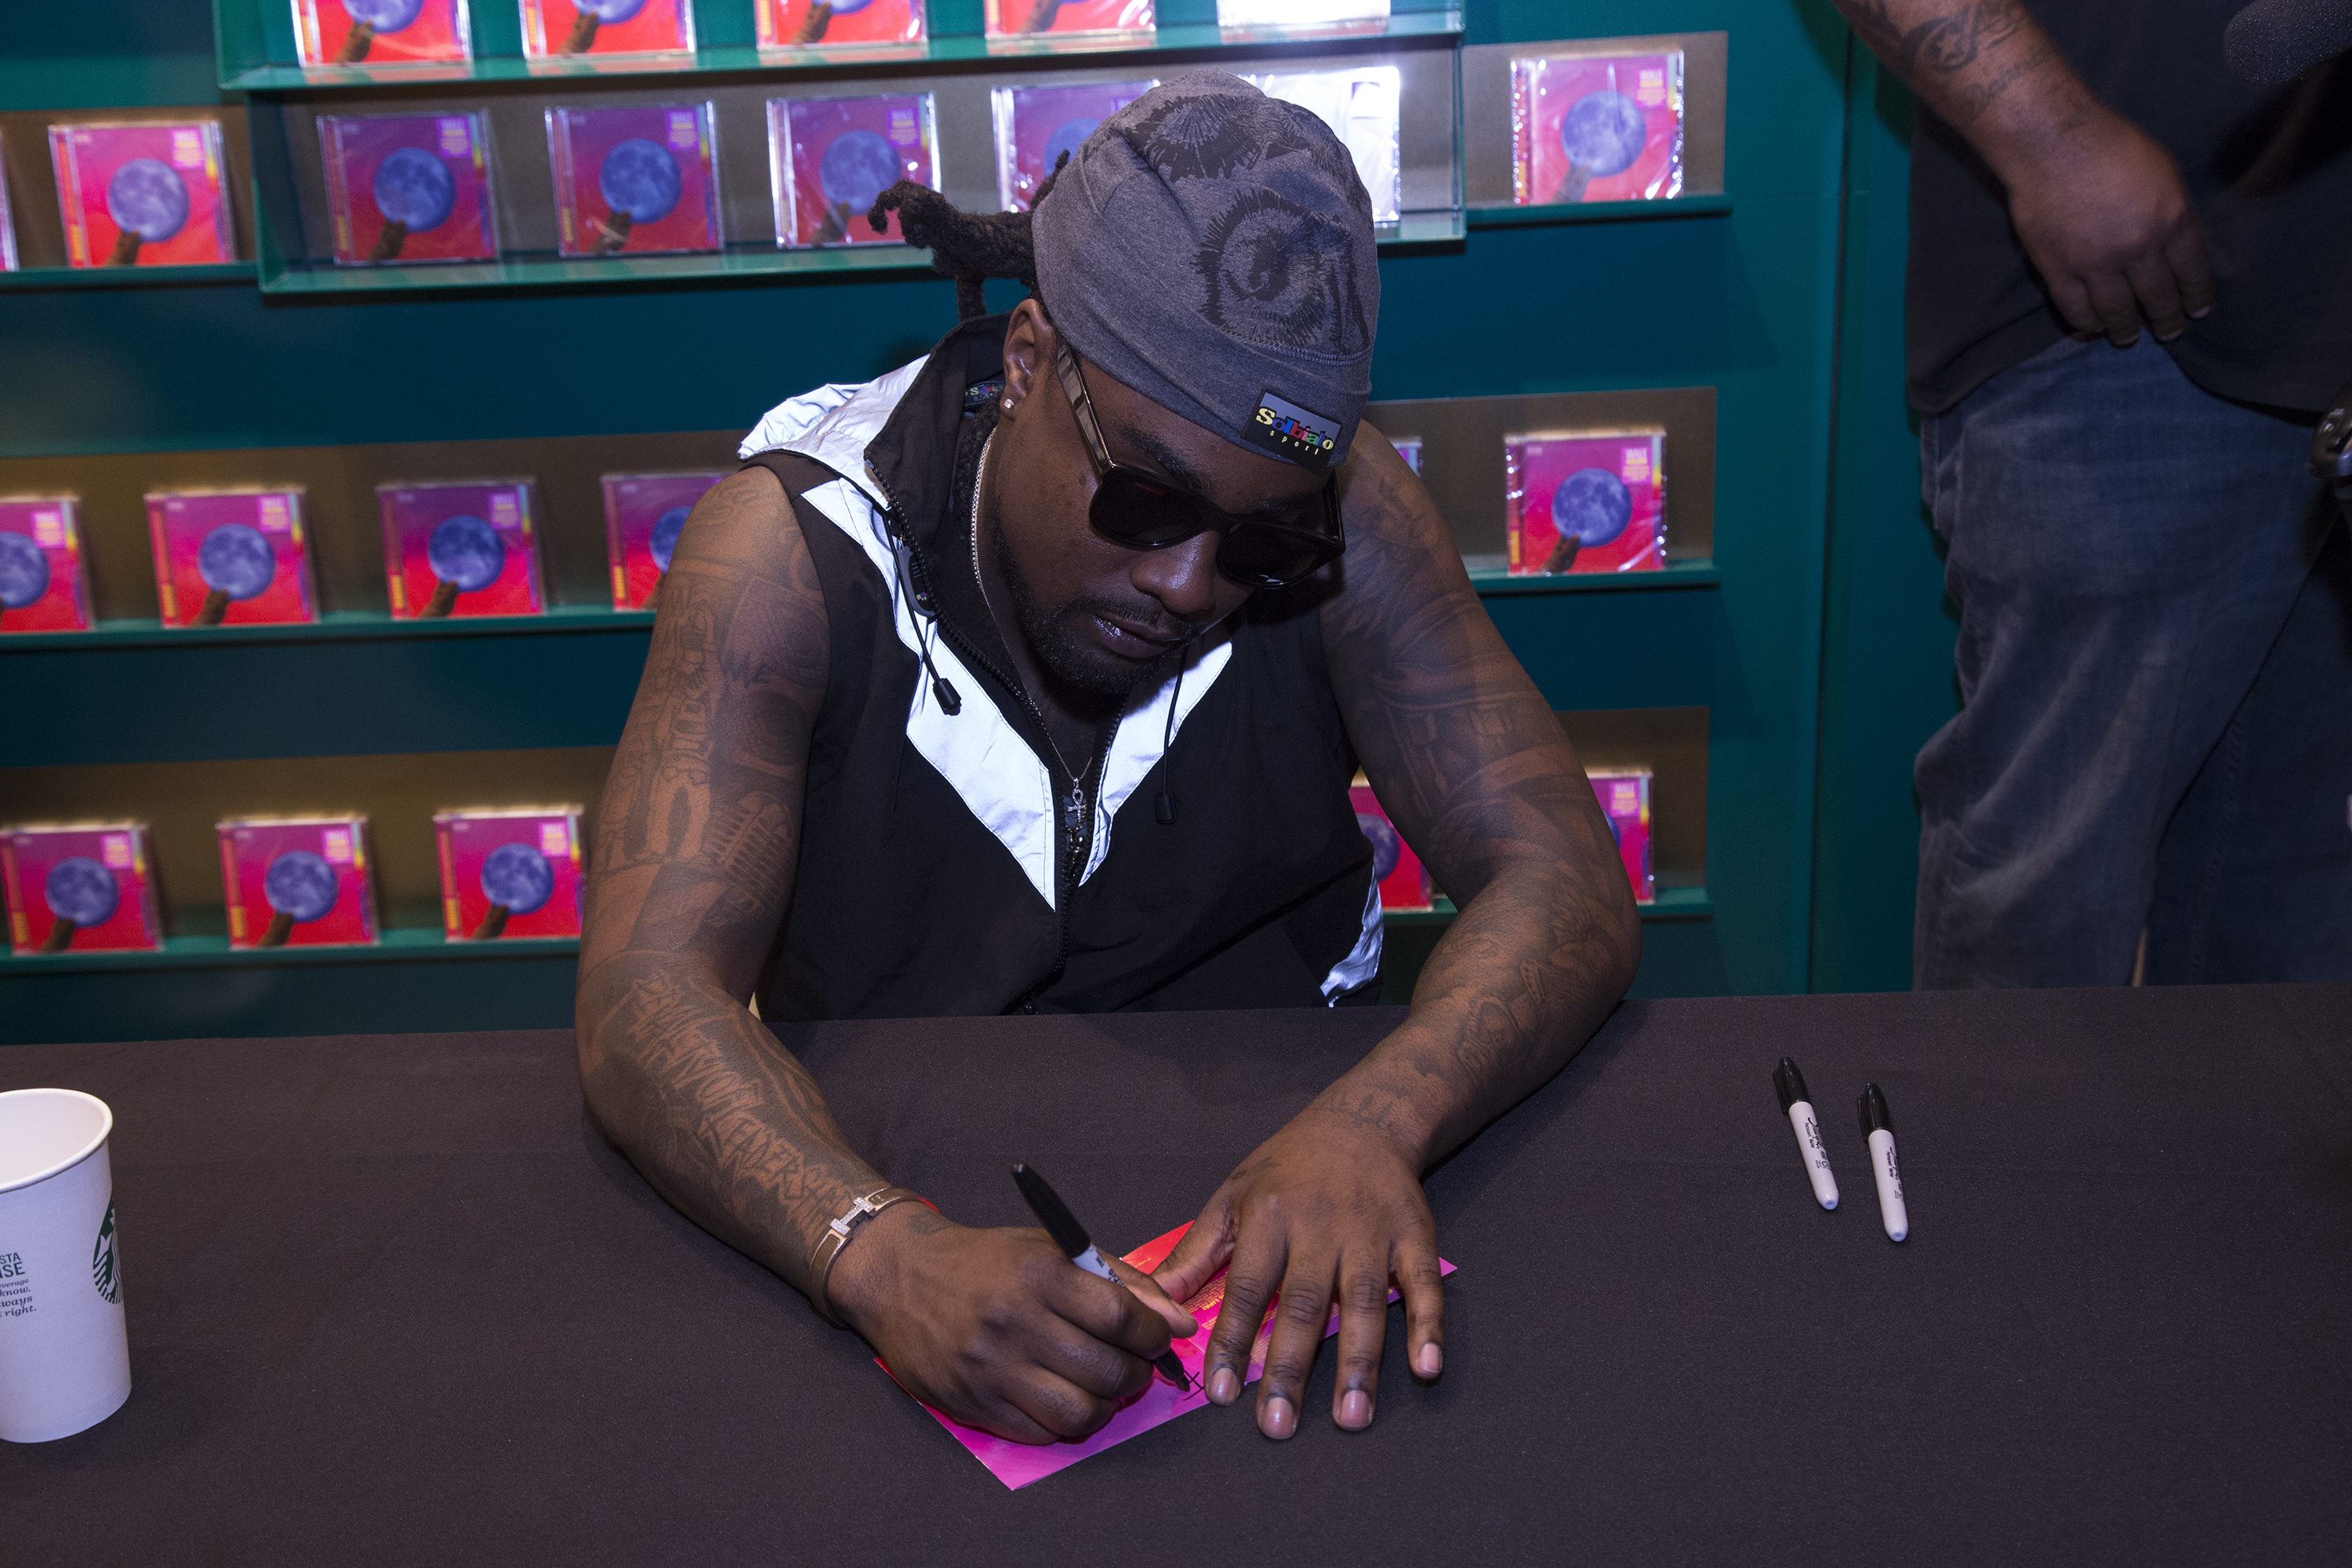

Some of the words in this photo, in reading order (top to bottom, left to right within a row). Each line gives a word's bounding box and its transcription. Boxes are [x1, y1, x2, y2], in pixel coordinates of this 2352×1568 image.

[1256, 408, 1334, 449] Solbiato
[1269, 430, 1319, 456] sport
[5, 1305, 36, 1317] right.
